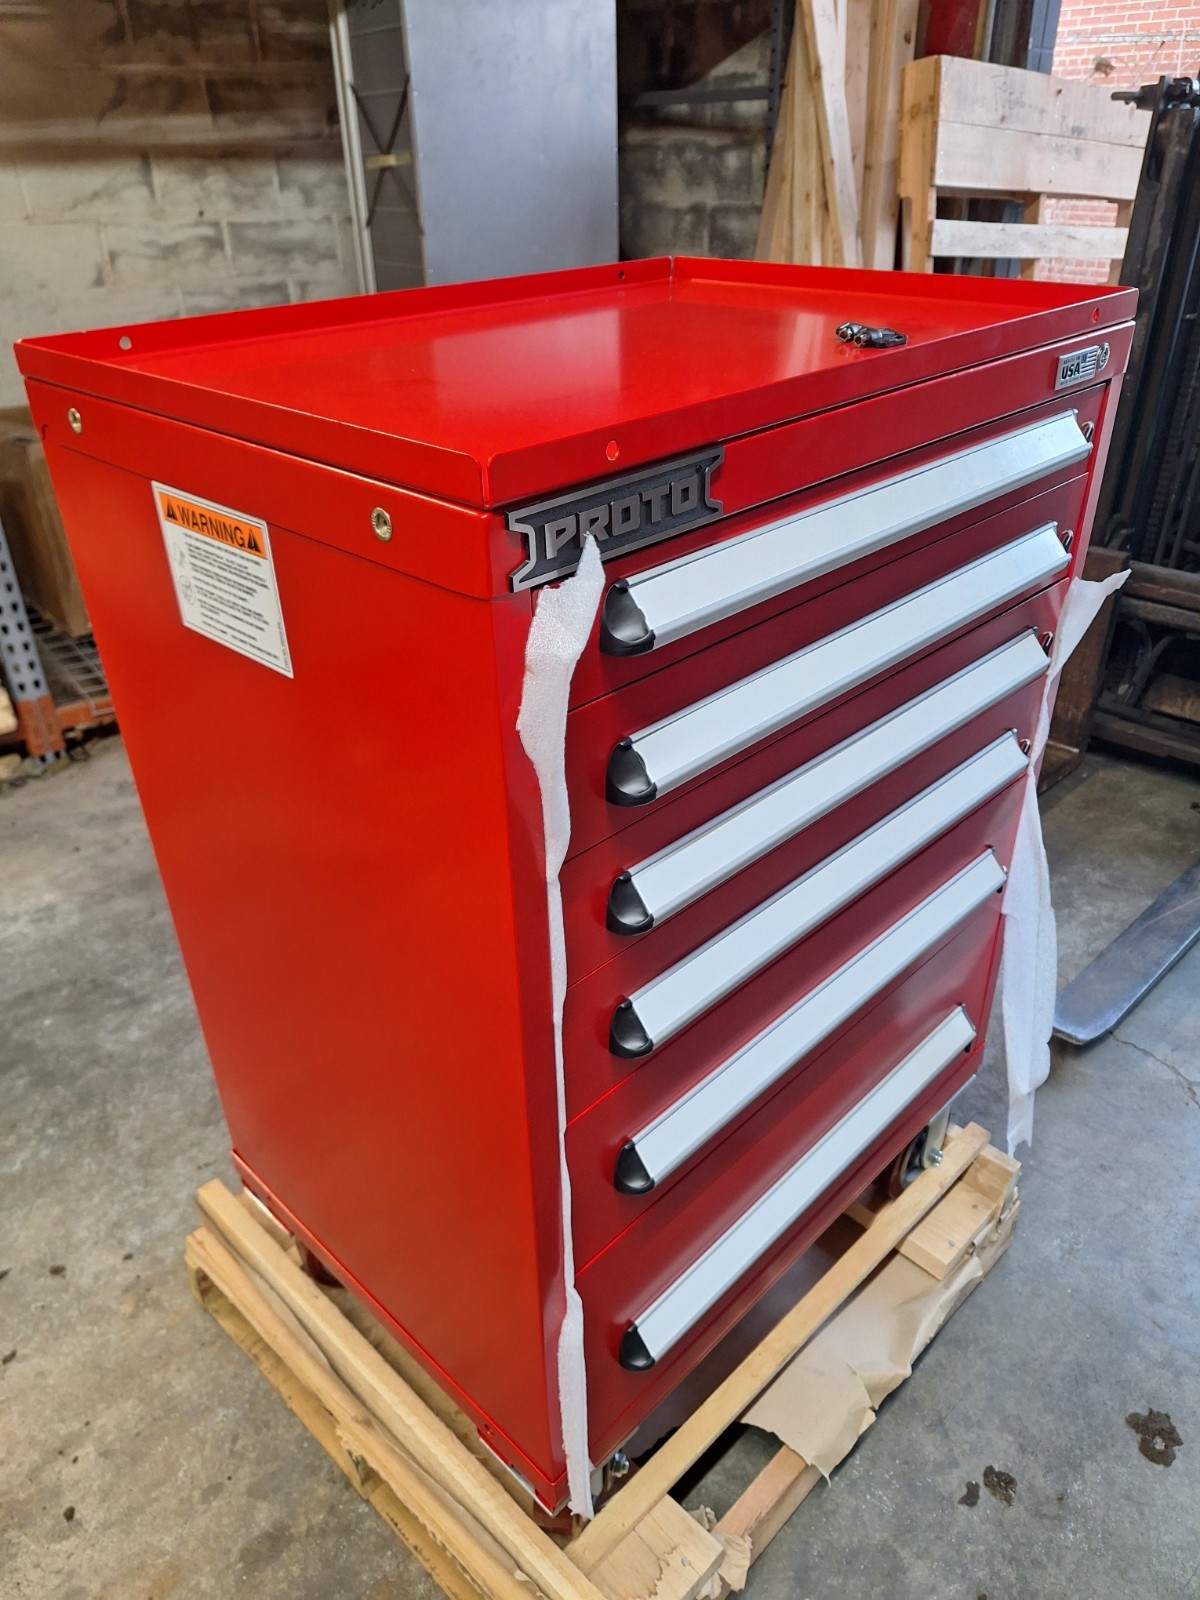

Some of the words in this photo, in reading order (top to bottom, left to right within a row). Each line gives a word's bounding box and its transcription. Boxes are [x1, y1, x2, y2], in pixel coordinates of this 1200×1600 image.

[1061, 362, 1080, 379] USA
[177, 503, 246, 548] WARNING
[544, 474, 699, 560] PROTO
